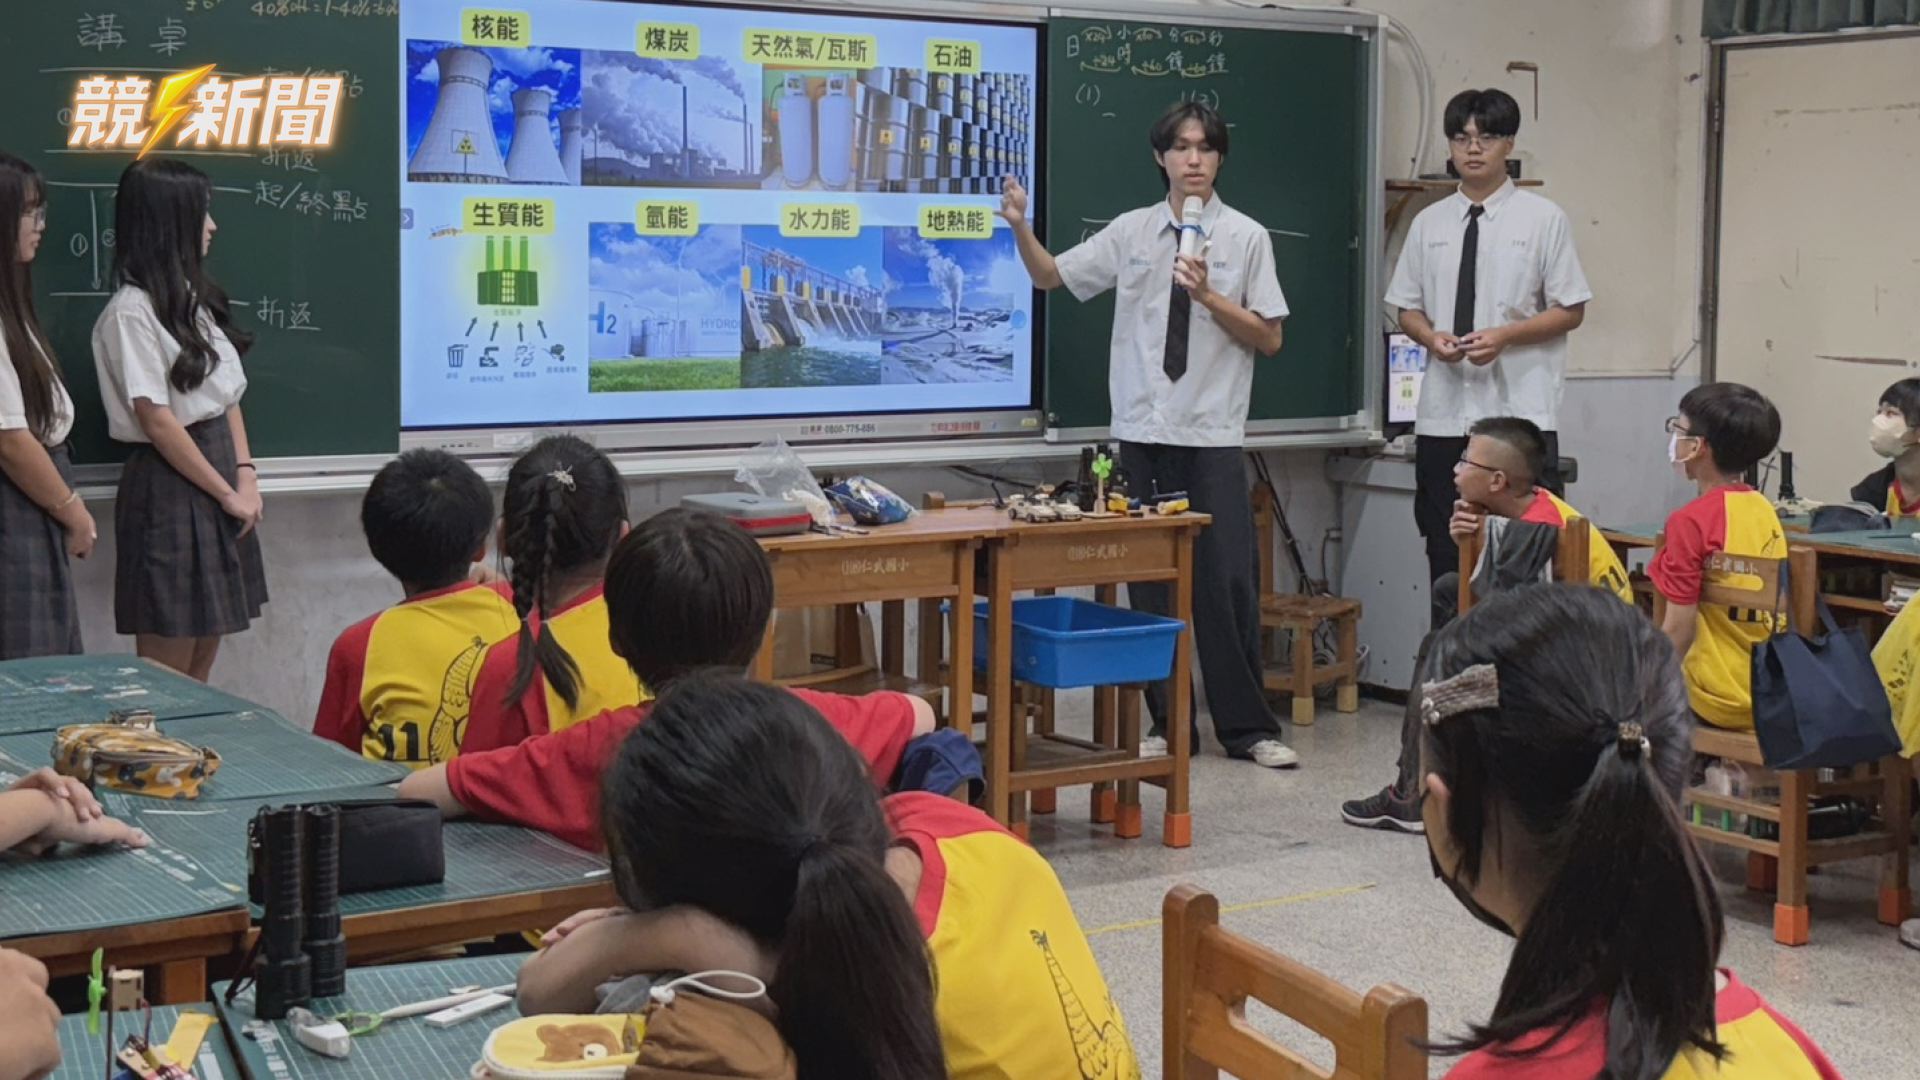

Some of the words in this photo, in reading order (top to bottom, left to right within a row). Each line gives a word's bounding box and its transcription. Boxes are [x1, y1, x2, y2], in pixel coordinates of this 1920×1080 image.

[472, 14, 519, 41] 核能
[645, 27, 689, 52] 煤炭
[752, 34, 867, 62] 天然氣/瓦斯
[934, 44, 972, 67] 石油
[1075, 83, 1100, 106] (1)
[473, 202, 544, 227] 生質能
[645, 205, 688, 230] 氫能
[788, 207, 851, 231] 水力能
[927, 209, 984, 233] 地熱能
